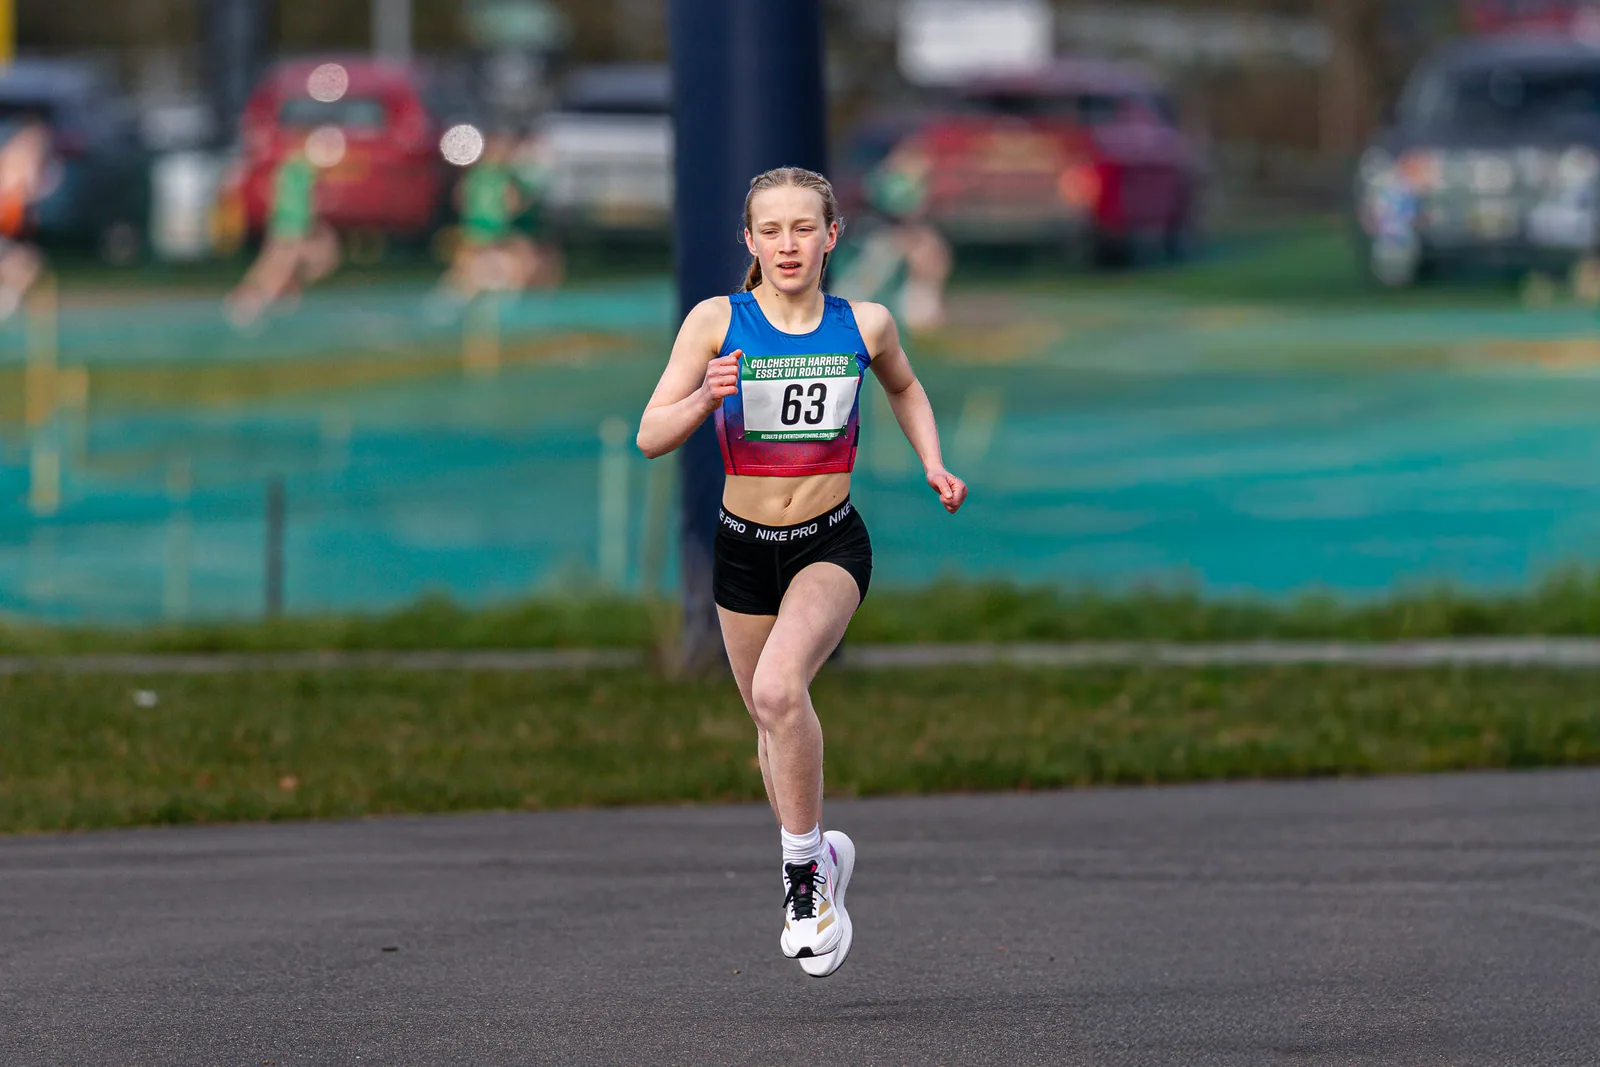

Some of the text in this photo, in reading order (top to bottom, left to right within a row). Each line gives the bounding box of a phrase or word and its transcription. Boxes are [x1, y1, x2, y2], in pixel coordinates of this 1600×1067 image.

[751, 356, 849, 369] COLCHESTER HARRIERS
[755, 368, 784, 379] ESSEX
[799, 366, 823, 377] ROAD
[824, 365, 846, 376] RACE
[780, 383, 827, 426] 63
[829, 500, 851, 527] NIKE
[723, 515, 746, 534] PRO
[755, 522, 818, 542] NIKE PRO
